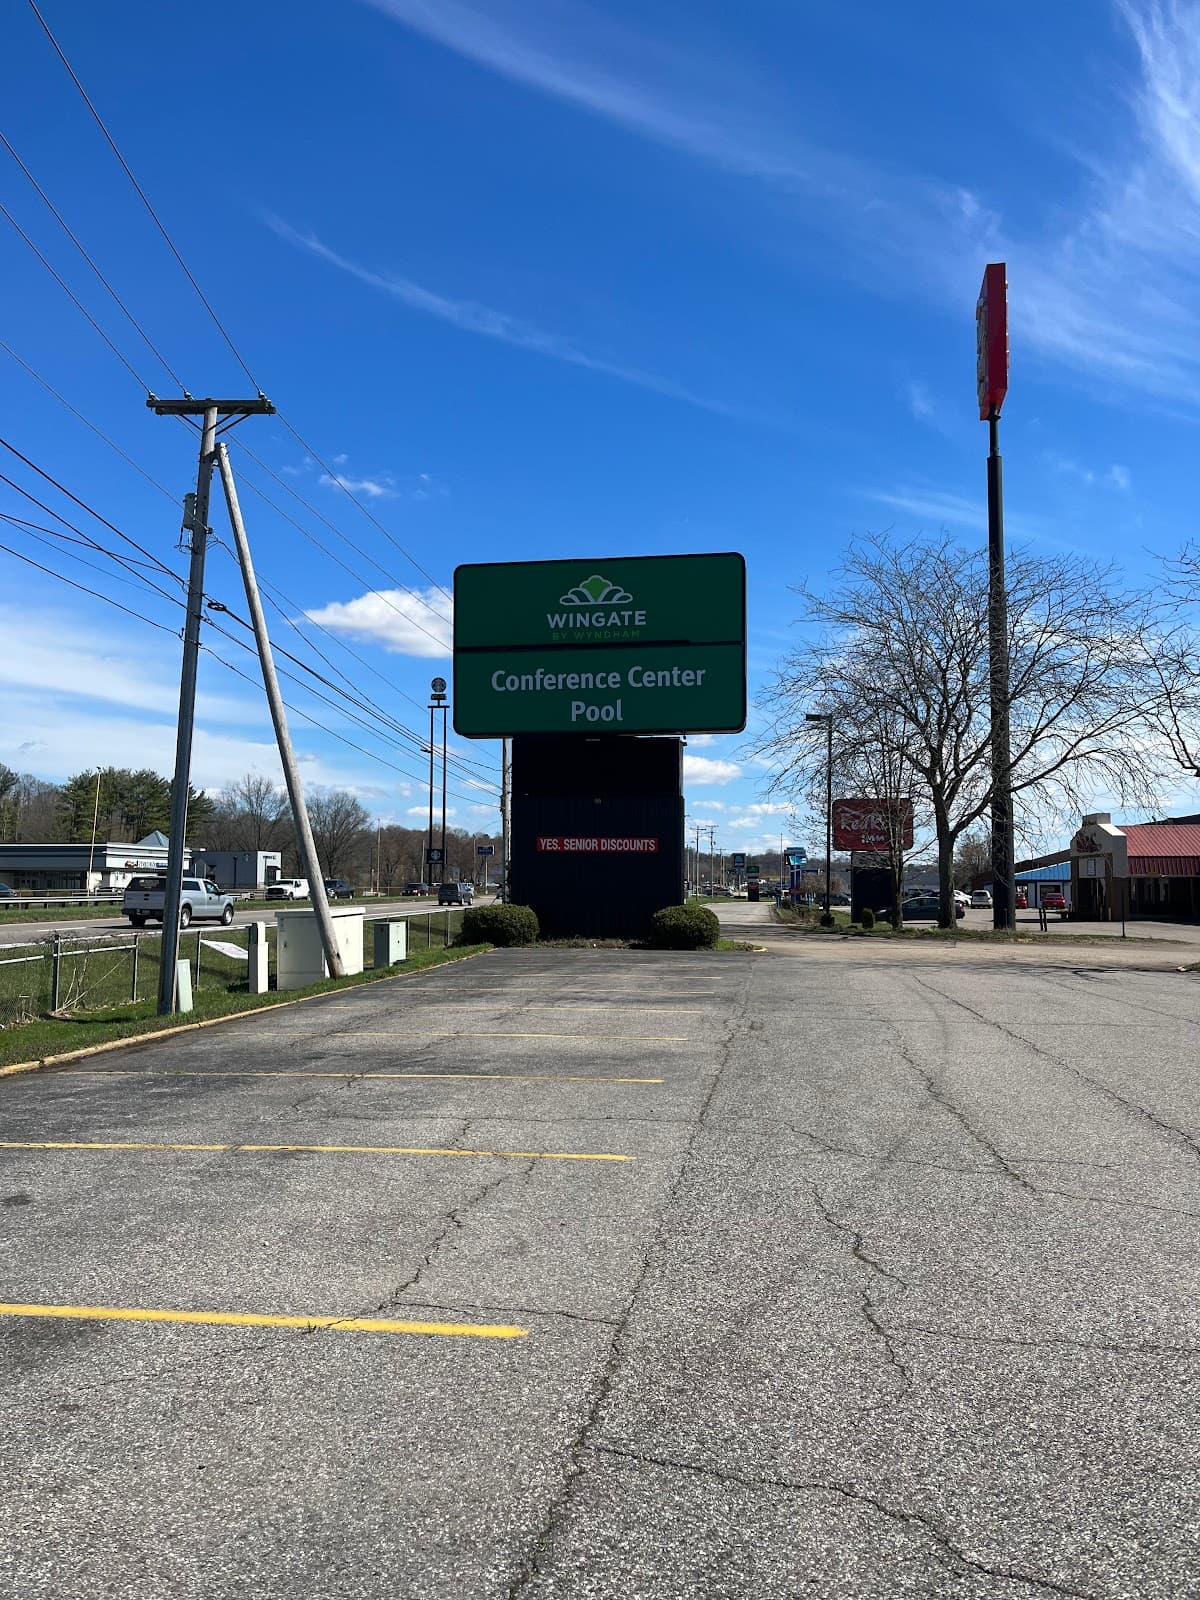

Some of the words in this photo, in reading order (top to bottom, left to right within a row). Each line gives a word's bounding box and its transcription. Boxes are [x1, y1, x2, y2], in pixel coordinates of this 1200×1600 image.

[546, 610, 646, 629] WINGATE
[552, 631, 568, 641] BY
[573, 629, 640, 641] WYNDHAM
[491, 668, 621, 692] Conference
[627, 665, 706, 688] Center
[571, 699, 623, 722] Pool
[540, 838, 561, 850] YES.
[563, 838, 599, 851] SENIOR
[601, 839, 656, 851] DISCOUNTS
